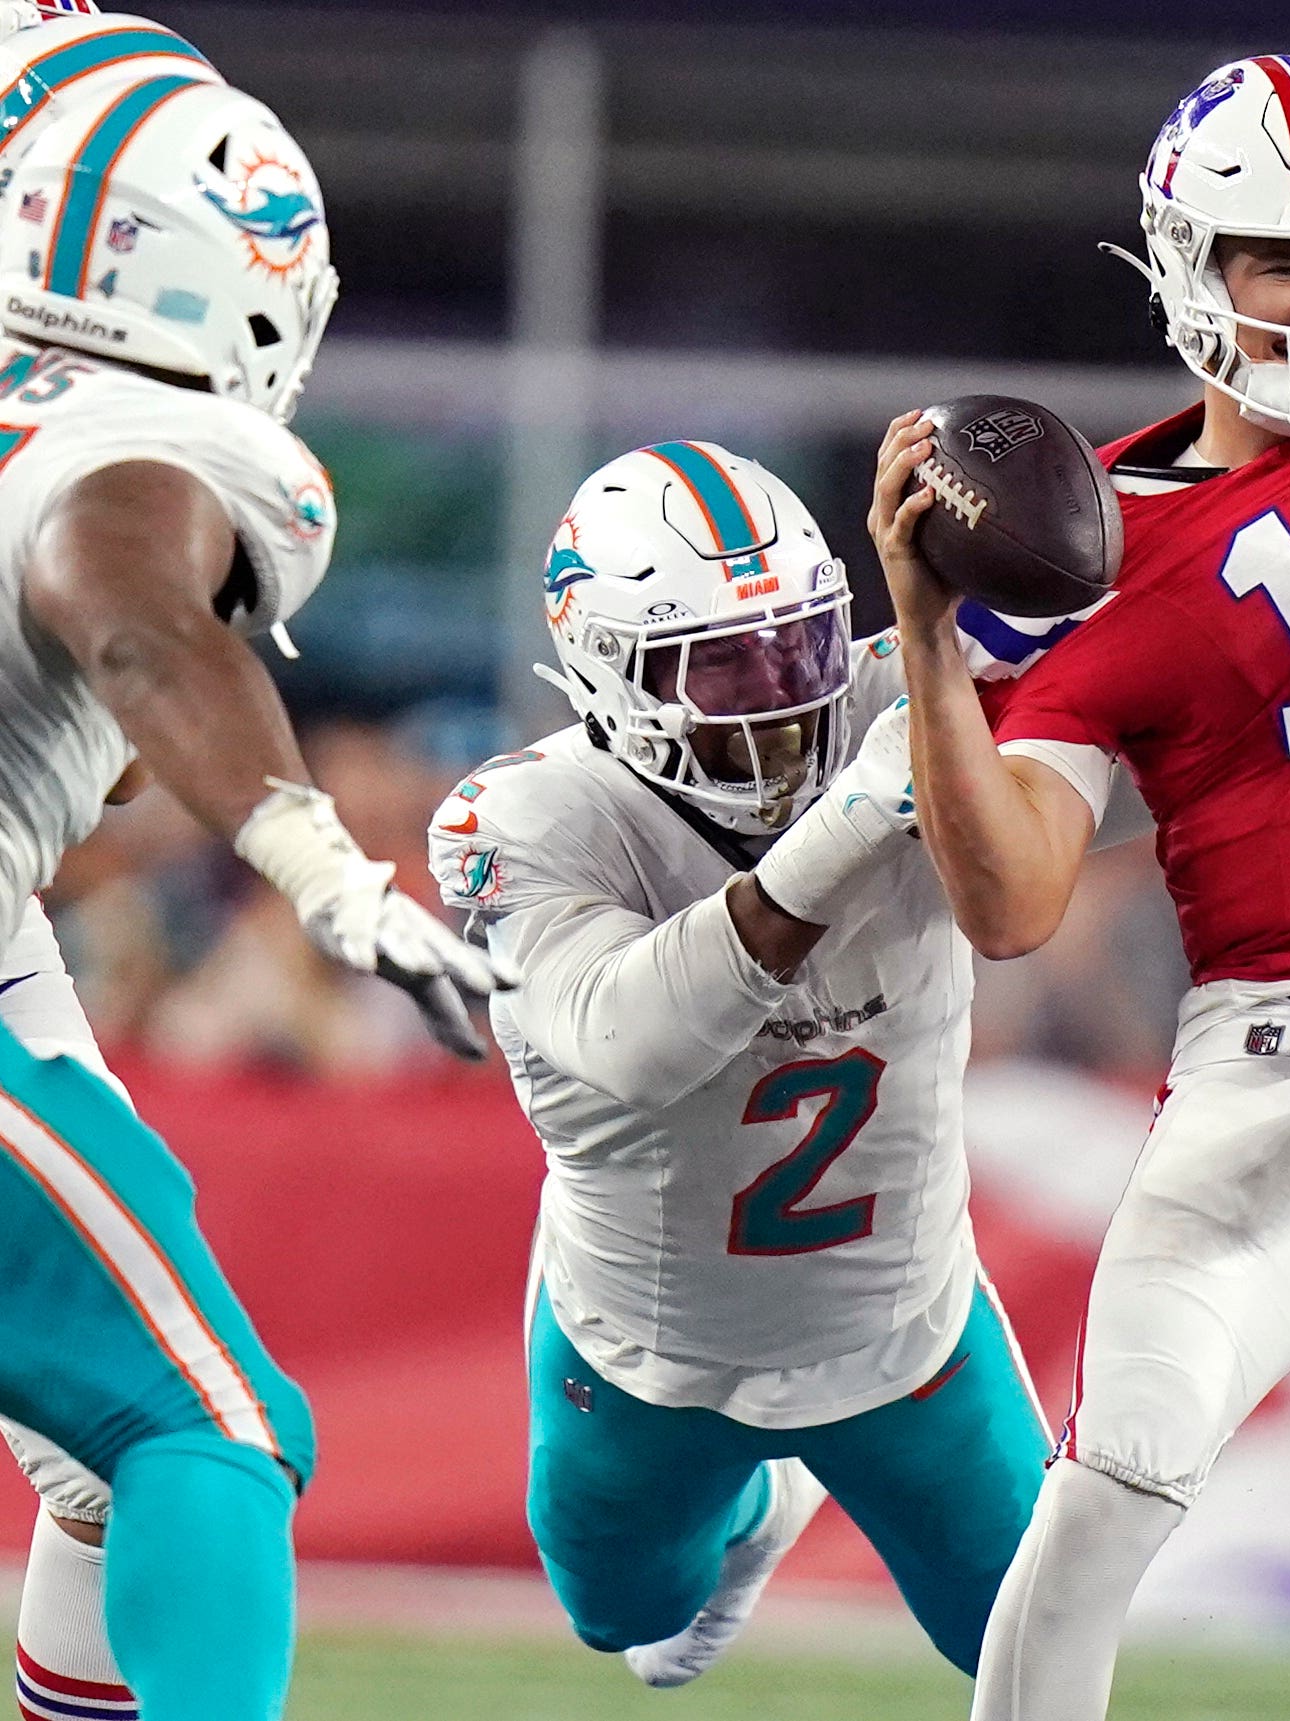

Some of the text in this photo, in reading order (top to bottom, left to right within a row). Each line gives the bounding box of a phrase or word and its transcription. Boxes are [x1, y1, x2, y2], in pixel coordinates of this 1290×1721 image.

[7, 295, 129, 343] Dolphins
[736, 576, 780, 600] MIAMI
[642, 610, 689, 626] OAKLEY
[726, 1046, 888, 1256] 2
